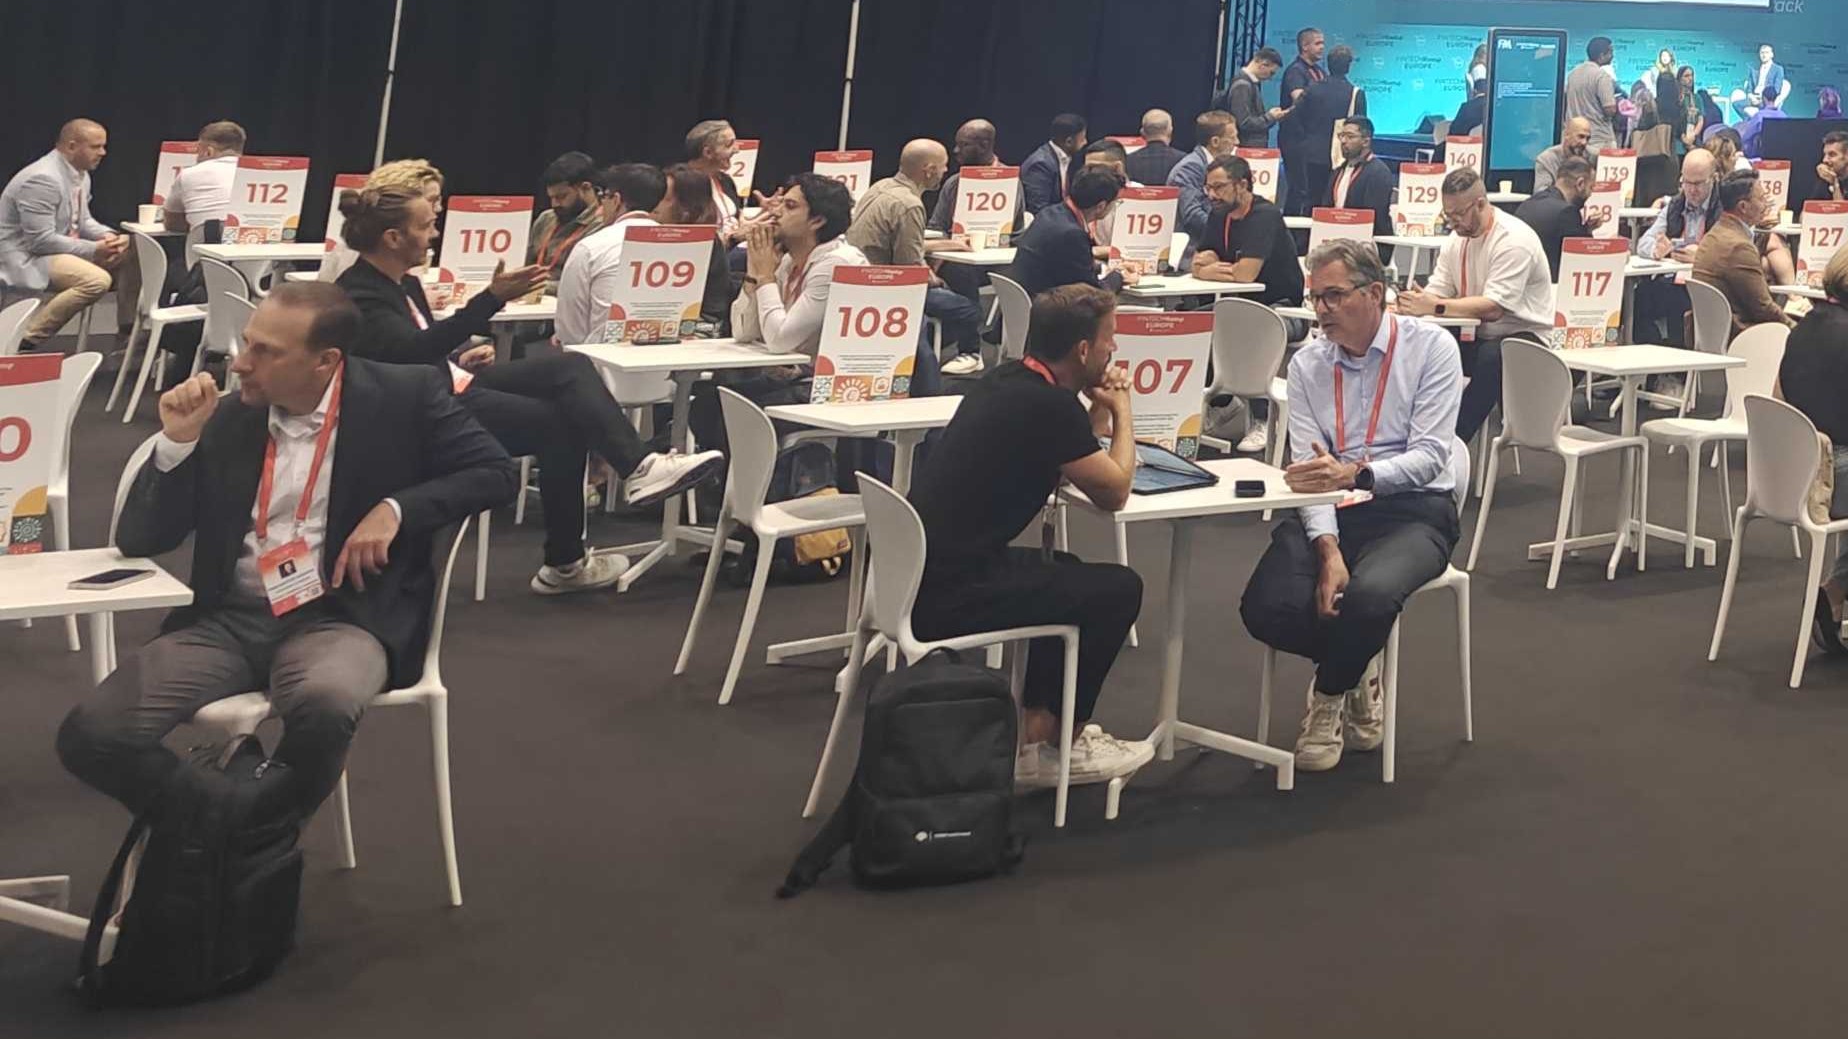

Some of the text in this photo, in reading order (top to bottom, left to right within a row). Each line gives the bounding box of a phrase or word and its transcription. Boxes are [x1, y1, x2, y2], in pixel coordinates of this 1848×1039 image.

[1449, 152, 1477, 167] 140
[1603, 166, 1629, 181] 139
[247, 183, 288, 204] 112
[1407, 186, 1438, 203] 129
[1763, 181, 1782, 195] 38
[966, 192, 1007, 211] 120
[1126, 214, 1163, 235] 119
[460, 229, 512, 253] 110
[1809, 227, 1844, 247] 127
[629, 261, 695, 288] 109
[1572, 272, 1612, 297] 117
[838, 306, 909, 338] 108
[1114, 359, 1193, 394] 07
